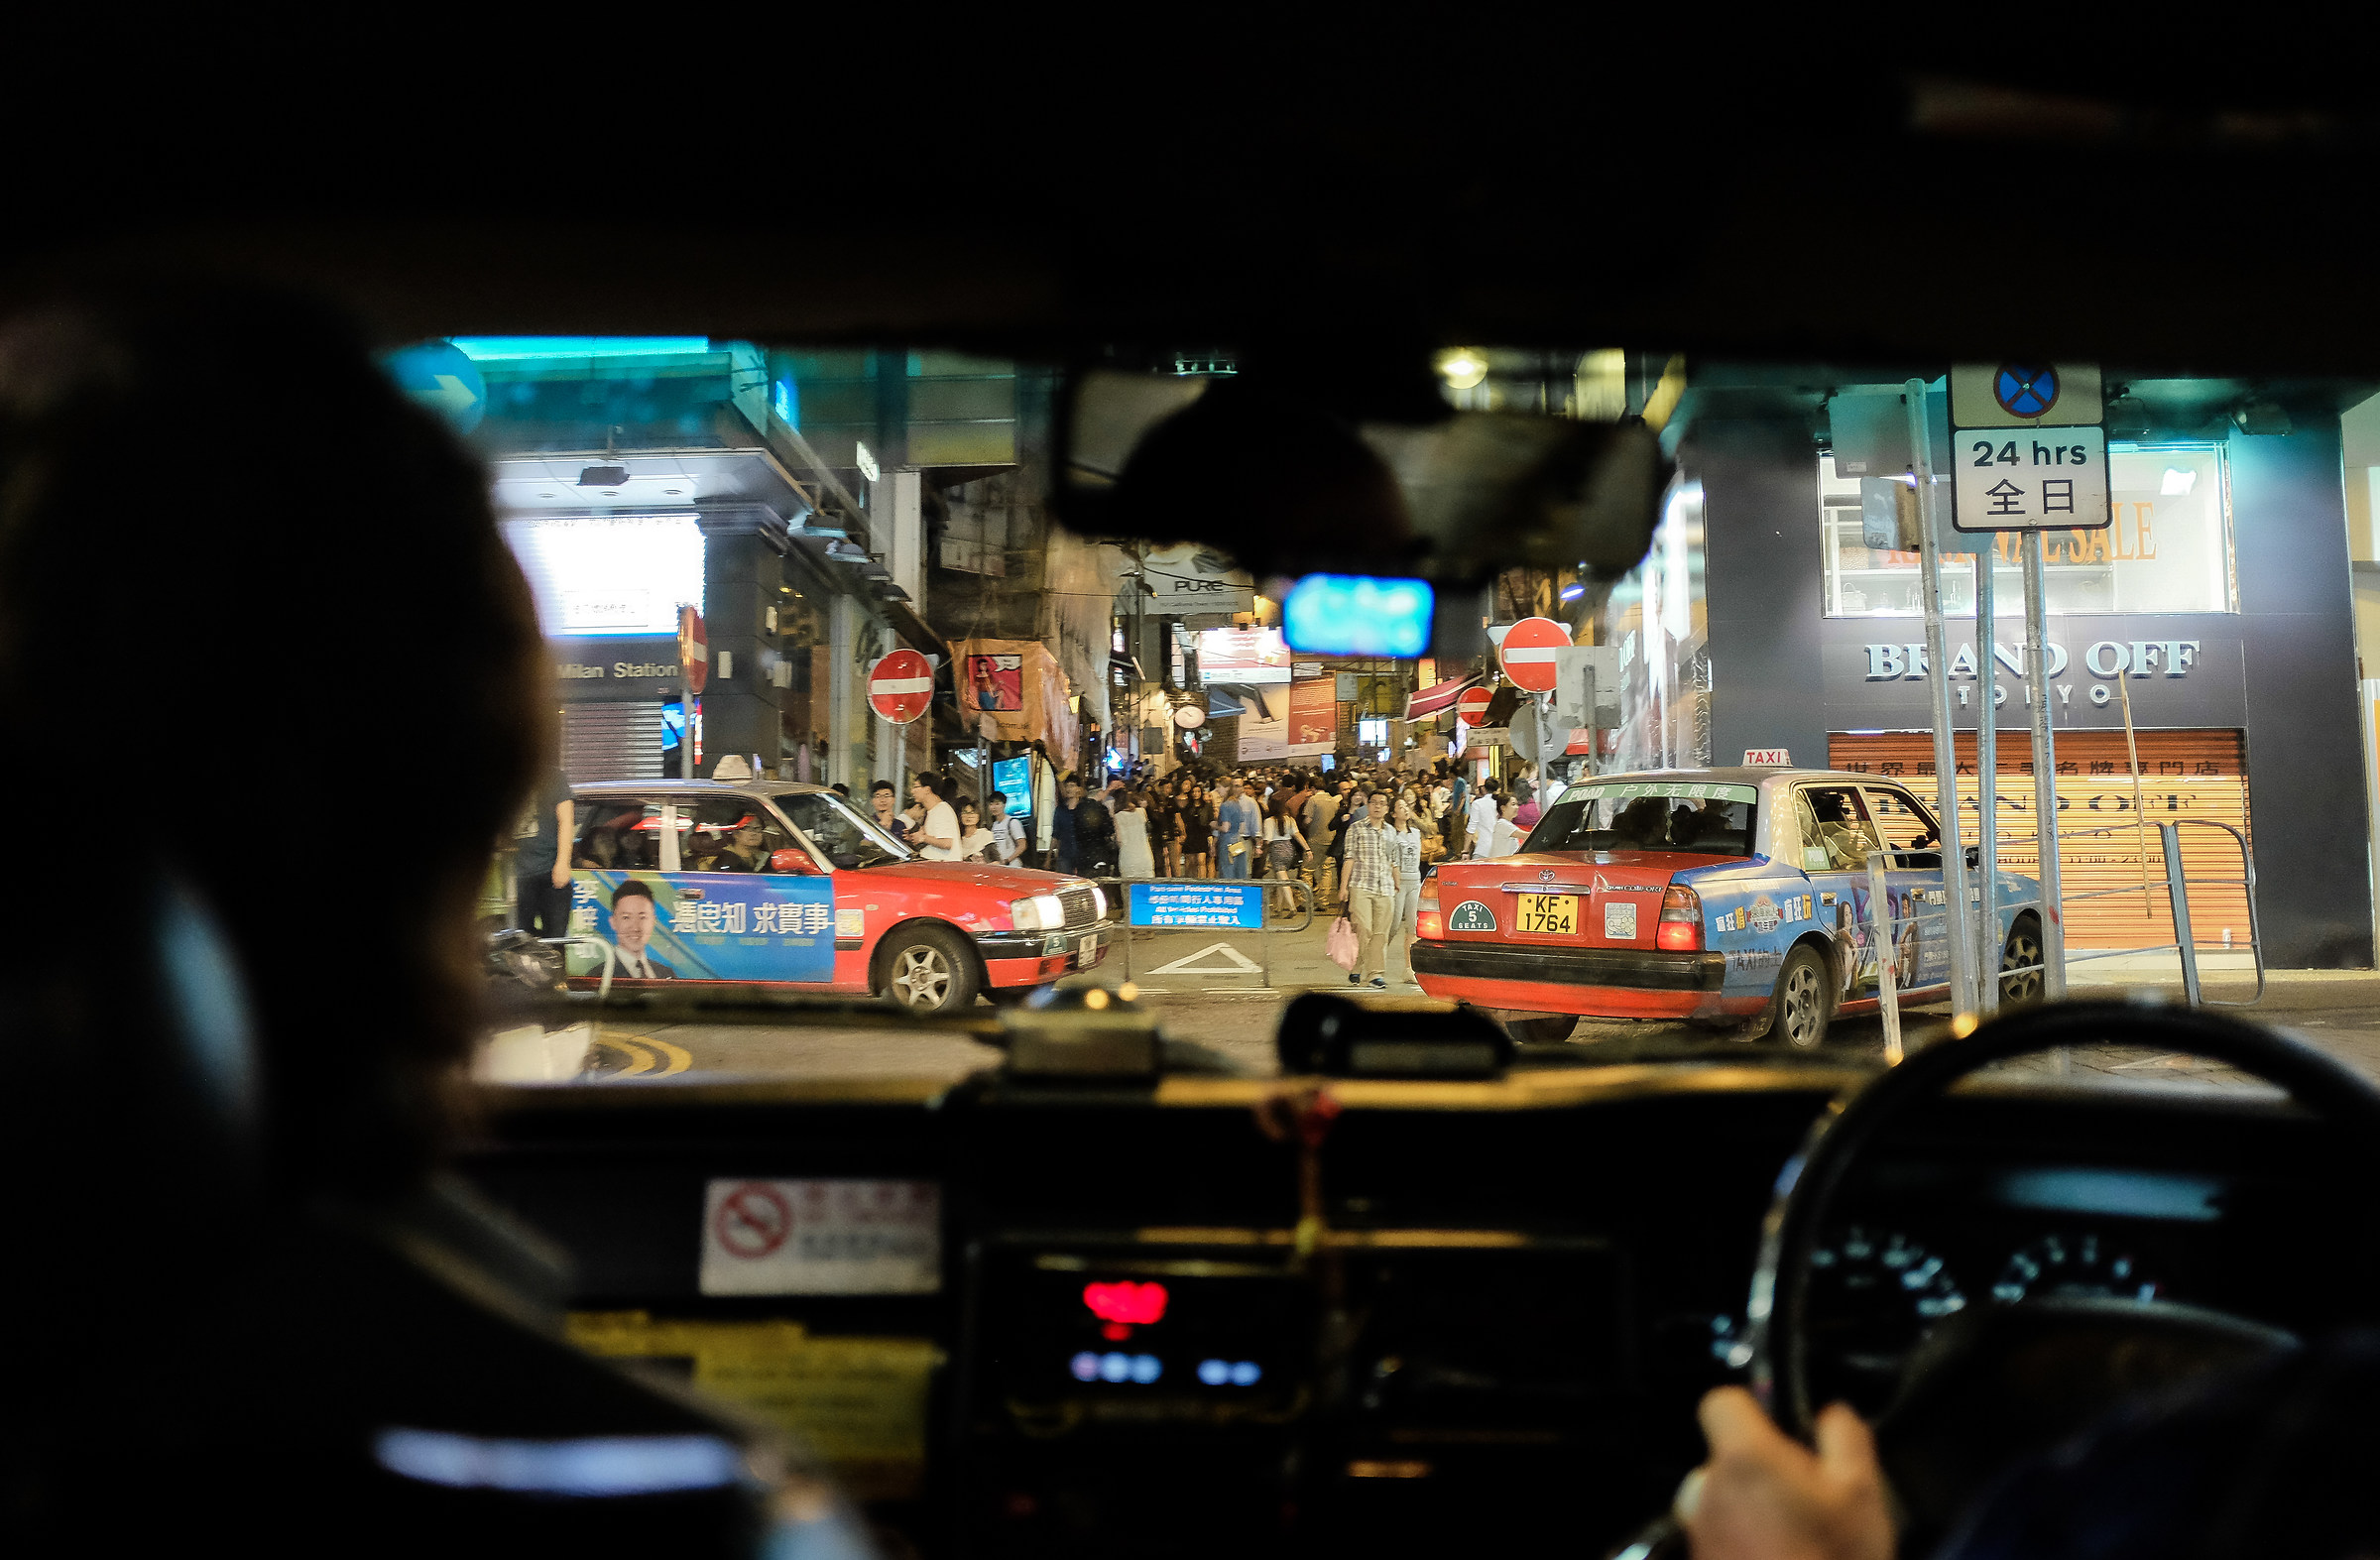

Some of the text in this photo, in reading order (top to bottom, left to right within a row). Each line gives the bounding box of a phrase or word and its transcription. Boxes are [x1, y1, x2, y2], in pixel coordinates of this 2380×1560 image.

[1972, 440, 2086, 467] 24 hrs
[1985, 478, 2075, 516] 全日
[1174, 580, 1224, 592] PURE
[2085, 641, 2201, 680] OFF
[614, 661, 678, 678] Station
[1958, 683, 2111, 705] TOYO
[1746, 751, 1781, 764] TAXI
[1567, 786, 1606, 802] POAD
[1462, 903, 1484, 912] TAXI
[1535, 896, 1561, 912] KF
[1468, 910, 1478, 923] 5
[1525, 912, 1571, 933] 1764
